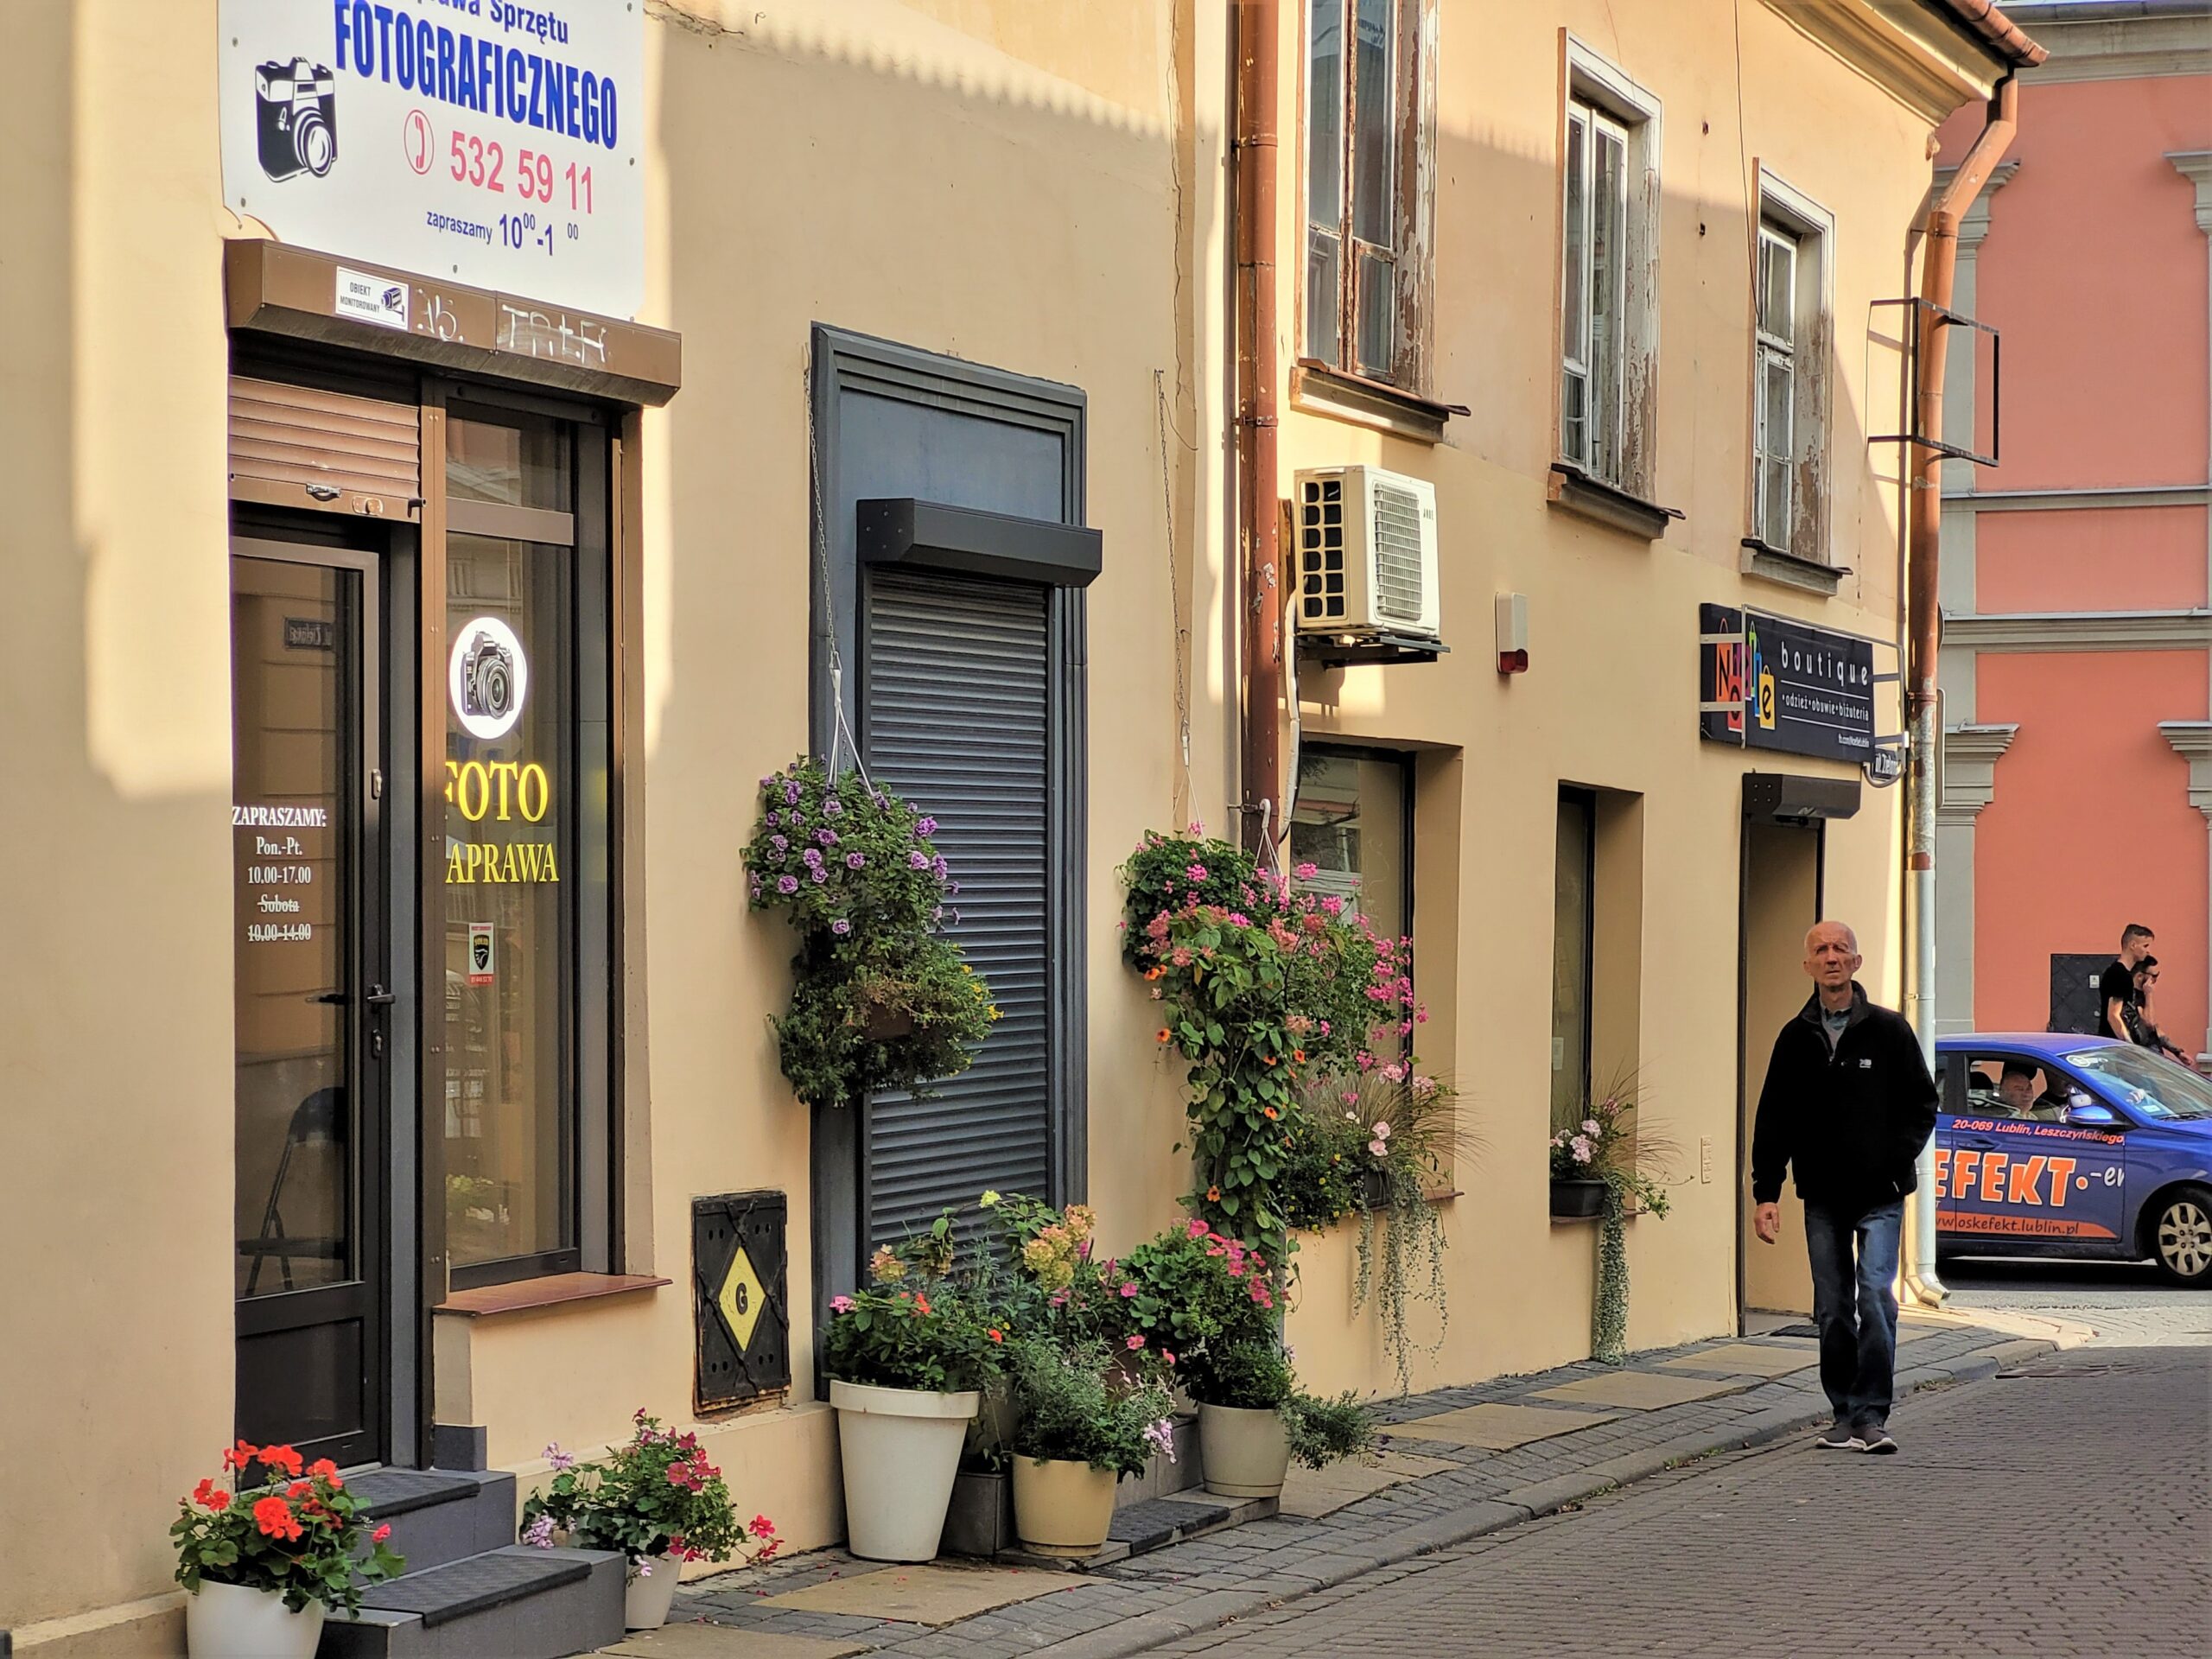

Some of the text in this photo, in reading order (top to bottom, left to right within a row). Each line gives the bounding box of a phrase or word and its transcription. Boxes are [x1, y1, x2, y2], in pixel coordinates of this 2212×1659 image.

[490, 0, 569, 44] Sprzętu
[334, 0, 617, 150] FOTOGRAFICZNEGO
[450, 130, 593, 214] 532 59 11
[426, 211, 493, 245] zapraszamy
[349, 282, 371, 296] OBIEKT
[340, 295, 380, 313] MONITOROWANY
[1782, 641, 1868, 687] boutique
[232, 806, 327, 828] ZAPRASZAMY:
[256, 836, 302, 855] Pon.-Pt.
[445, 842, 560, 883] APRAWA
[248, 866, 311, 884] 10.00-17.00
[259, 893, 300, 912] Sobota
[247, 923, 311, 942] 10.00-14.00
[1952, 1120, 1993, 1131] 20-069
[1995, 1123, 2032, 1136] Lublin,
[735, 1282, 748, 1315] G
